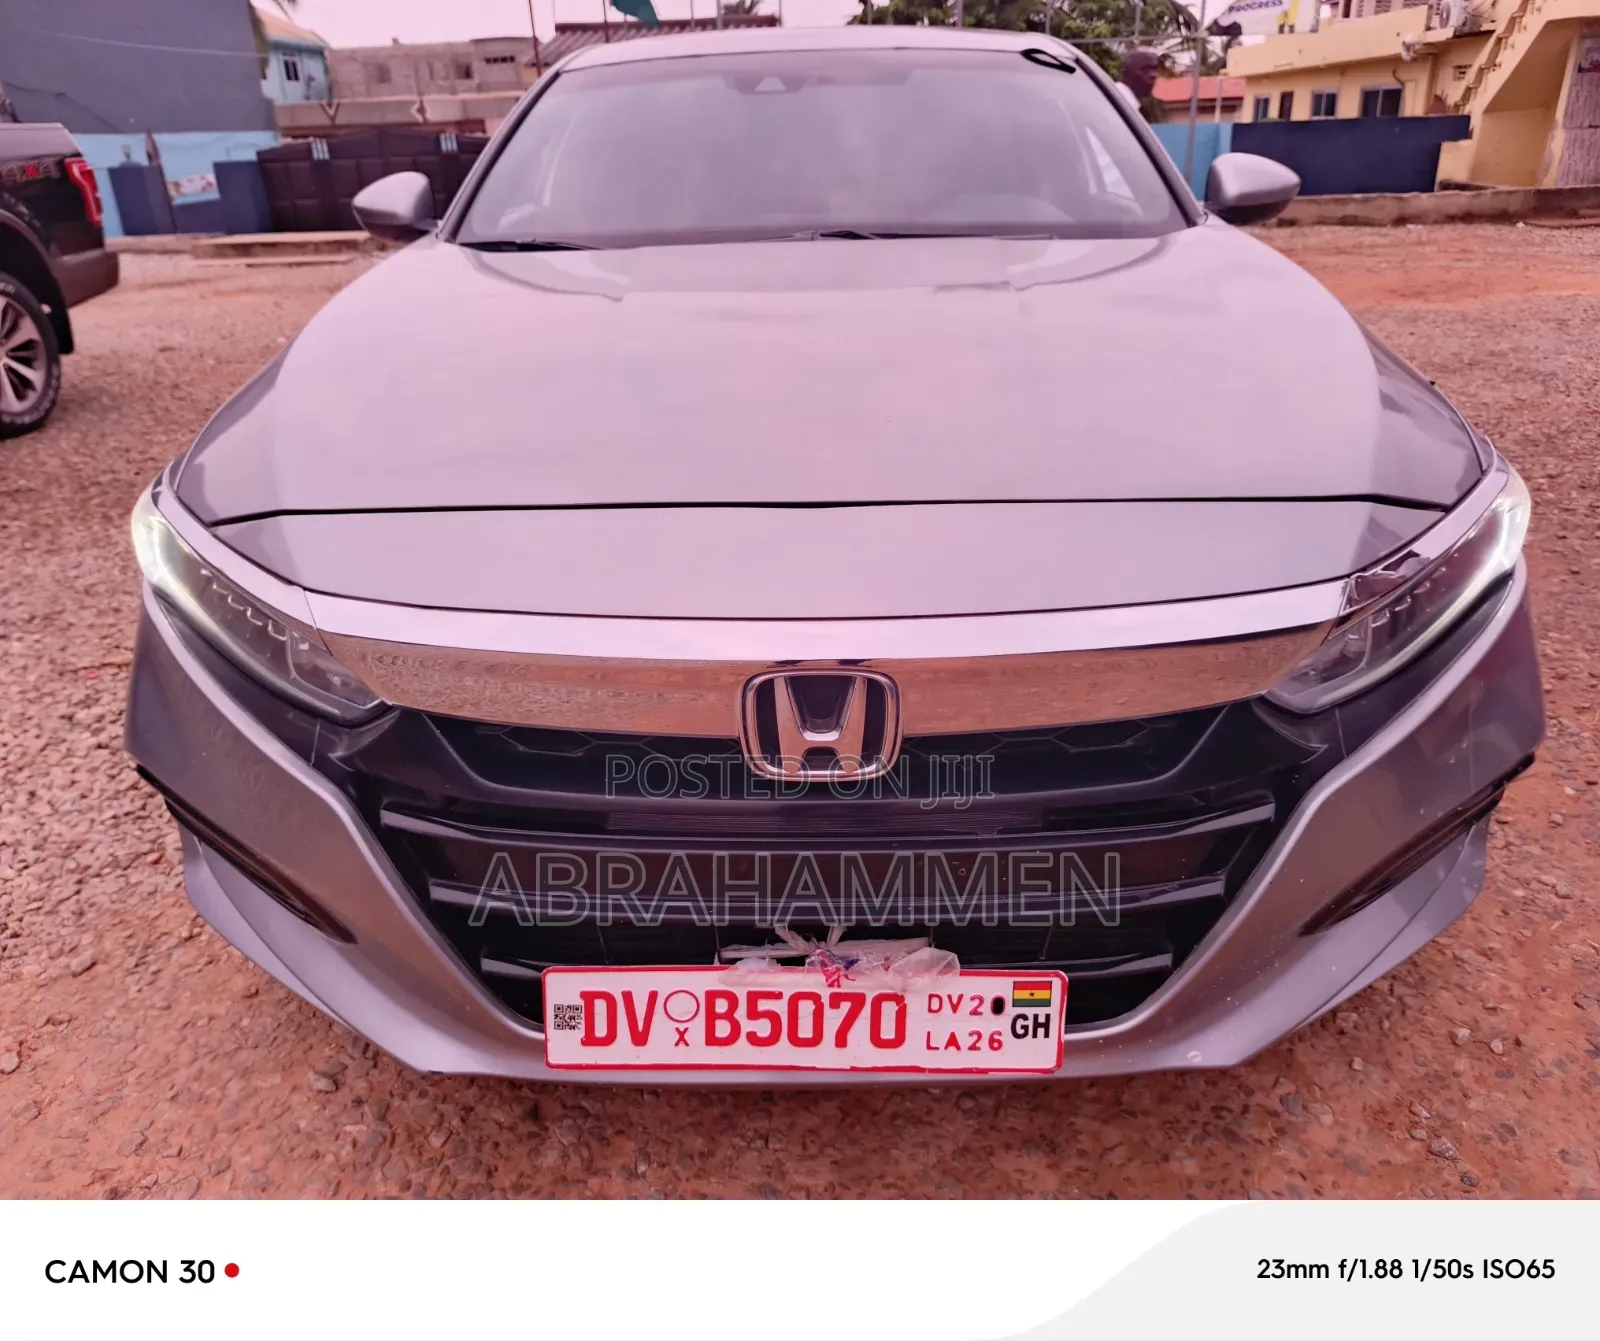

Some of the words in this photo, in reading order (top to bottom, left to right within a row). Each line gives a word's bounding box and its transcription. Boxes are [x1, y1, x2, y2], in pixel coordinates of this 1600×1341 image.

[579, 990, 659, 1047] DV
[704, 989, 907, 1049] B5070
[1010, 1013, 1050, 1039] GH
[925, 1030, 1004, 1051] LA26
